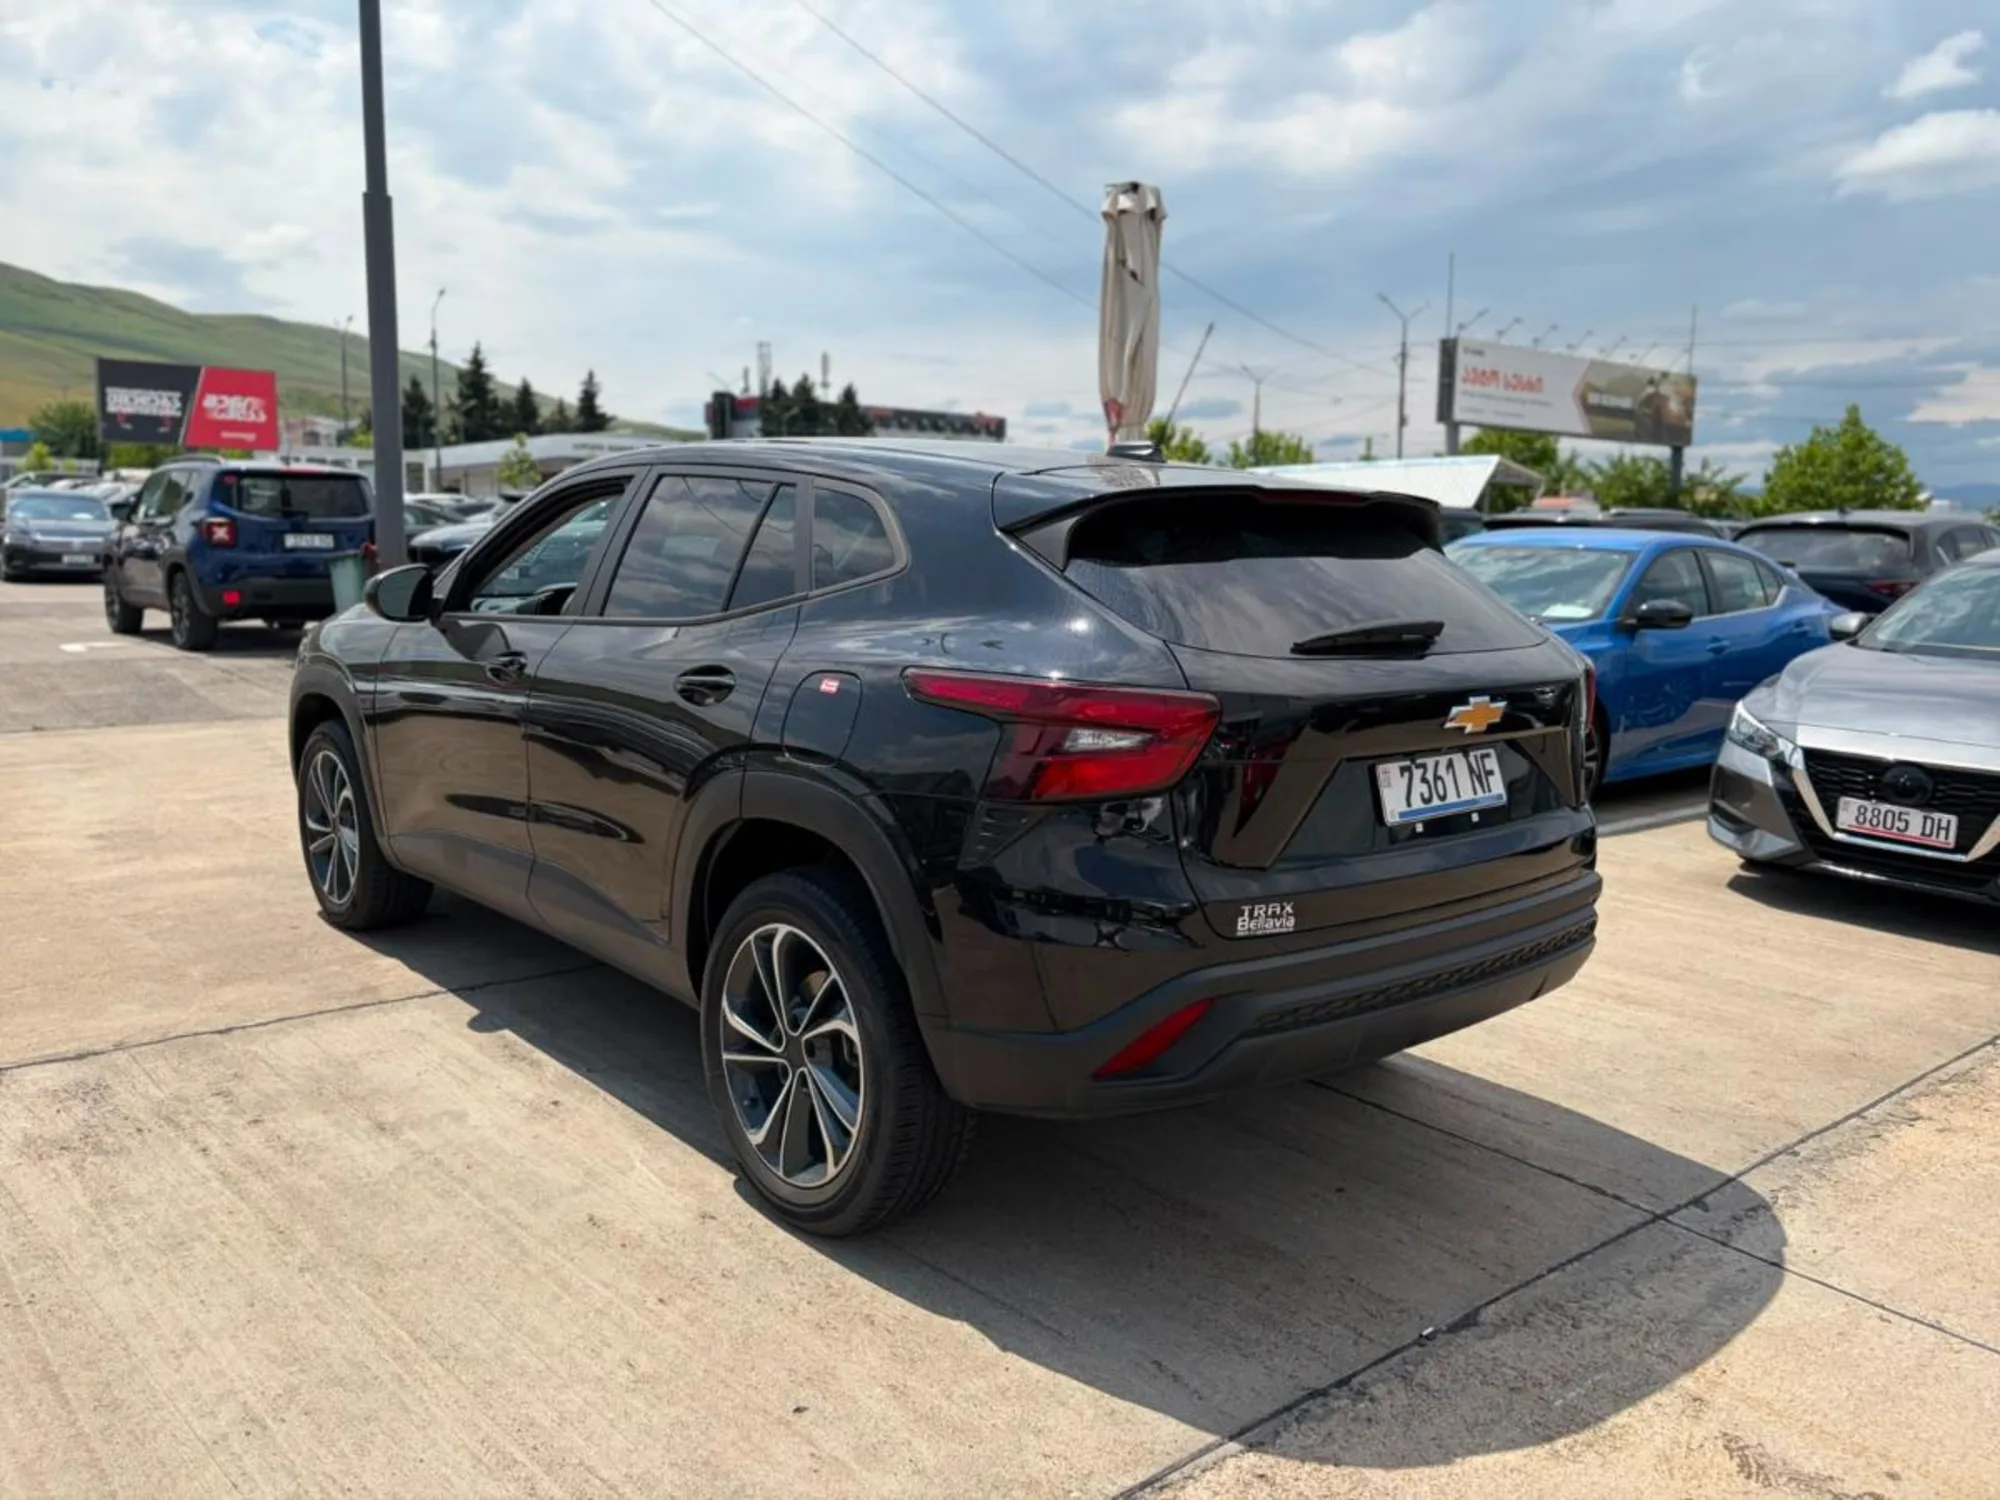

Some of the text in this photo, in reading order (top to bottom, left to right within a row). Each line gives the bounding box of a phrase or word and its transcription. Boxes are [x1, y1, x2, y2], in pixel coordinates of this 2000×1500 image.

[1399, 752, 1495, 808] 7361 NF
[1855, 804, 1951, 841] 8805 DH
[1240, 901, 1294, 917] TRAX
[1236, 915, 1296, 931] Bellavia
